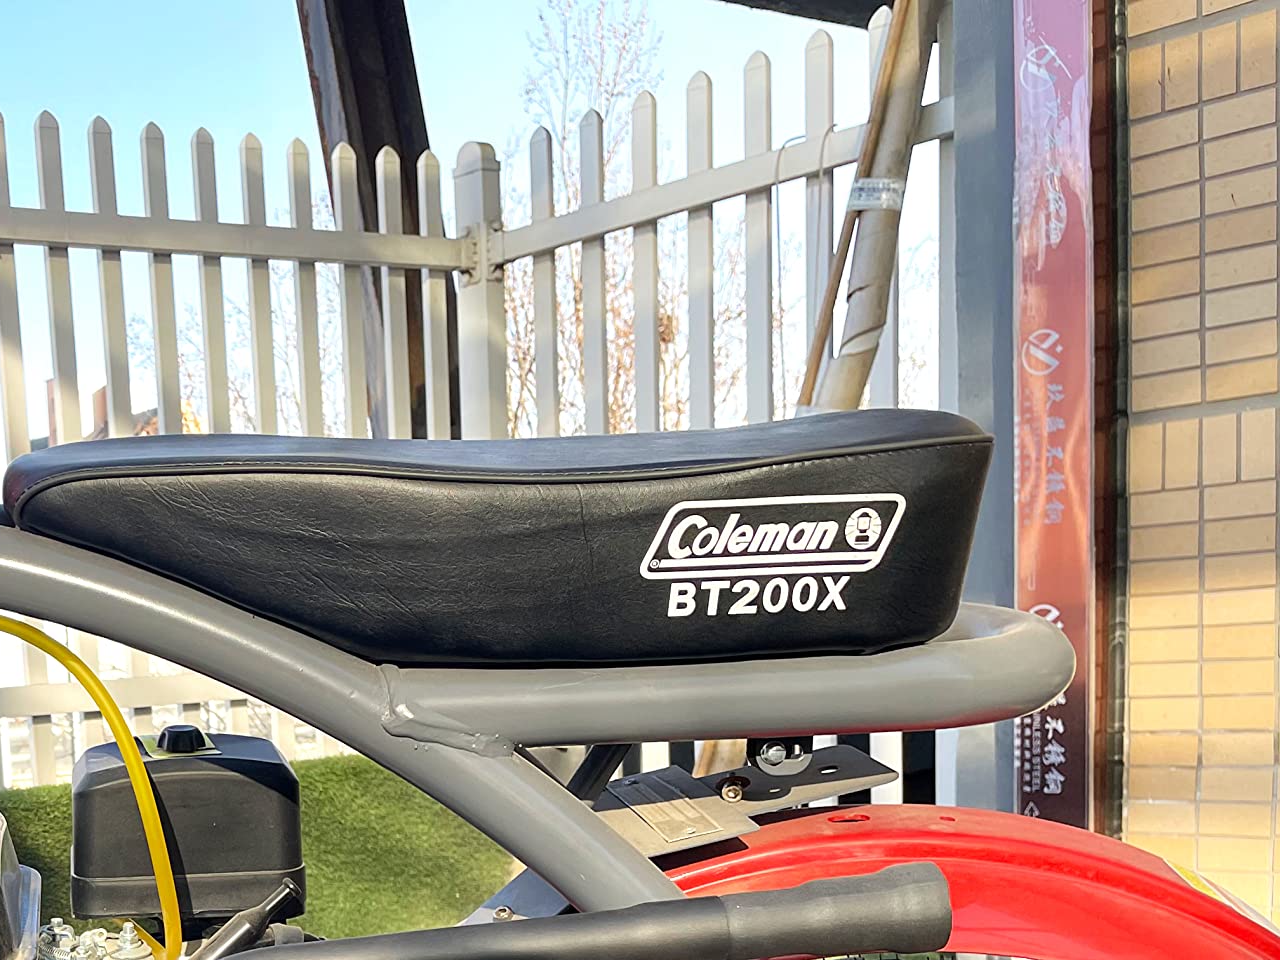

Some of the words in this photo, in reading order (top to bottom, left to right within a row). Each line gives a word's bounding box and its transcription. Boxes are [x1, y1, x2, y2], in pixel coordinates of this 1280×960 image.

[667, 512, 839, 559] Coleman
[667, 575, 851, 617] BT200X
[1032, 756, 1041, 792] STEEL
